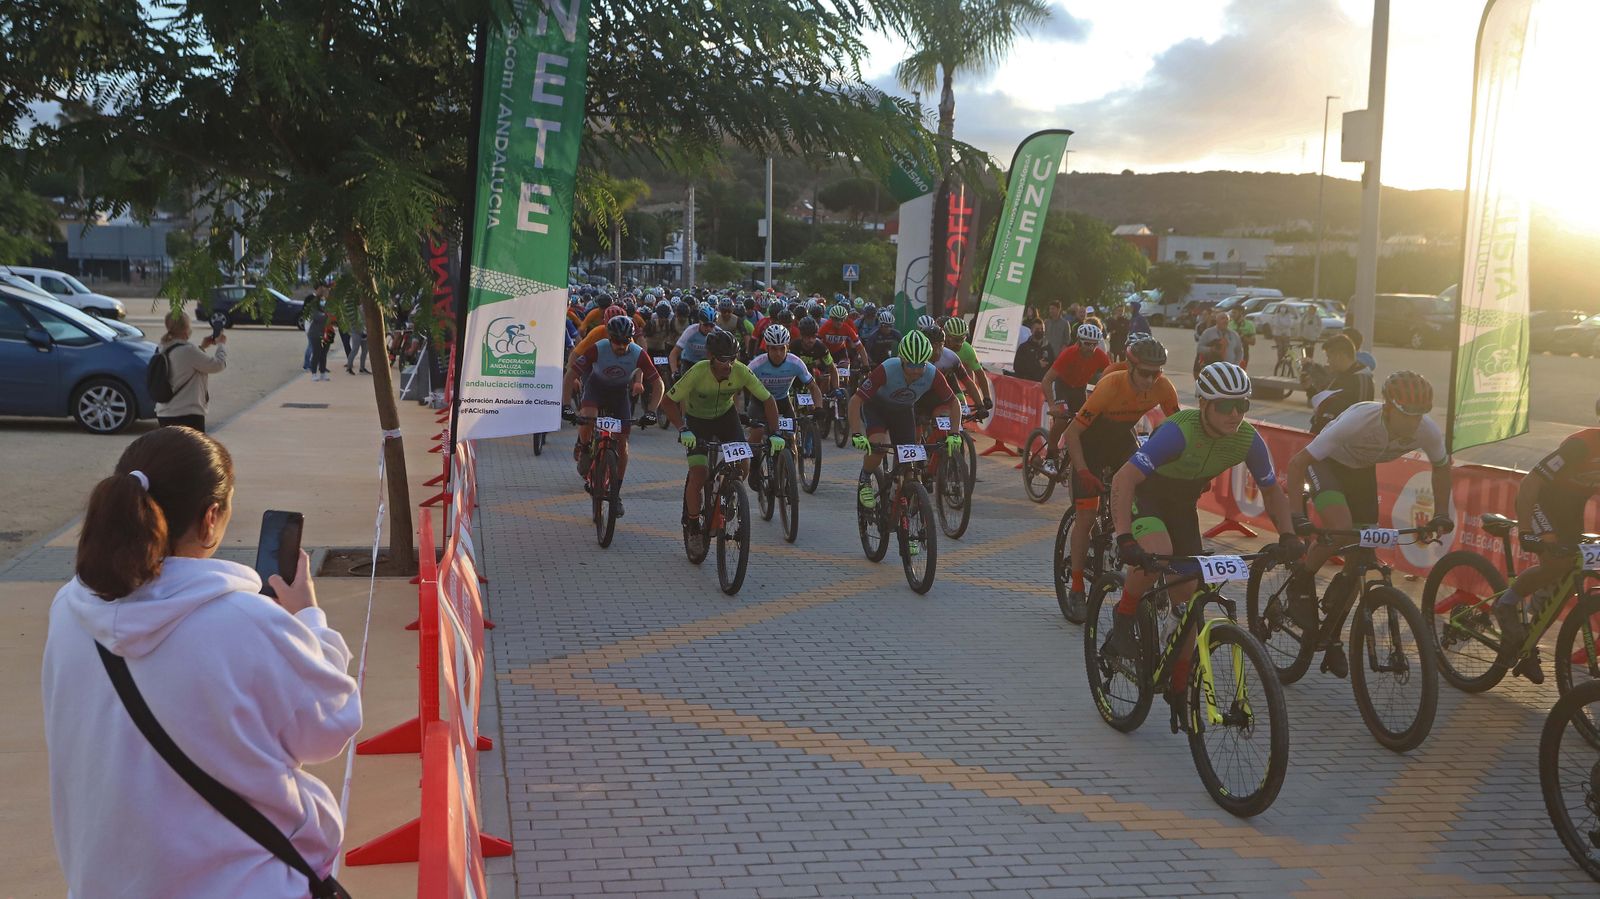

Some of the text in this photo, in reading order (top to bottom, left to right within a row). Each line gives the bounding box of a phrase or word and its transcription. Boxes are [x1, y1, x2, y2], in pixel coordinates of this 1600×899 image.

[487, 103, 512, 229] ANDALUCIA
[1007, 154, 1053, 283] ÚNETE
[465, 380, 554, 389] andaluciaciclismo.com
[598, 421, 616, 429] 107
[725, 447, 746, 458] 146
[902, 449, 917, 459] 28
[1363, 530, 1390, 544] 400
[1204, 560, 1237, 577] 165
